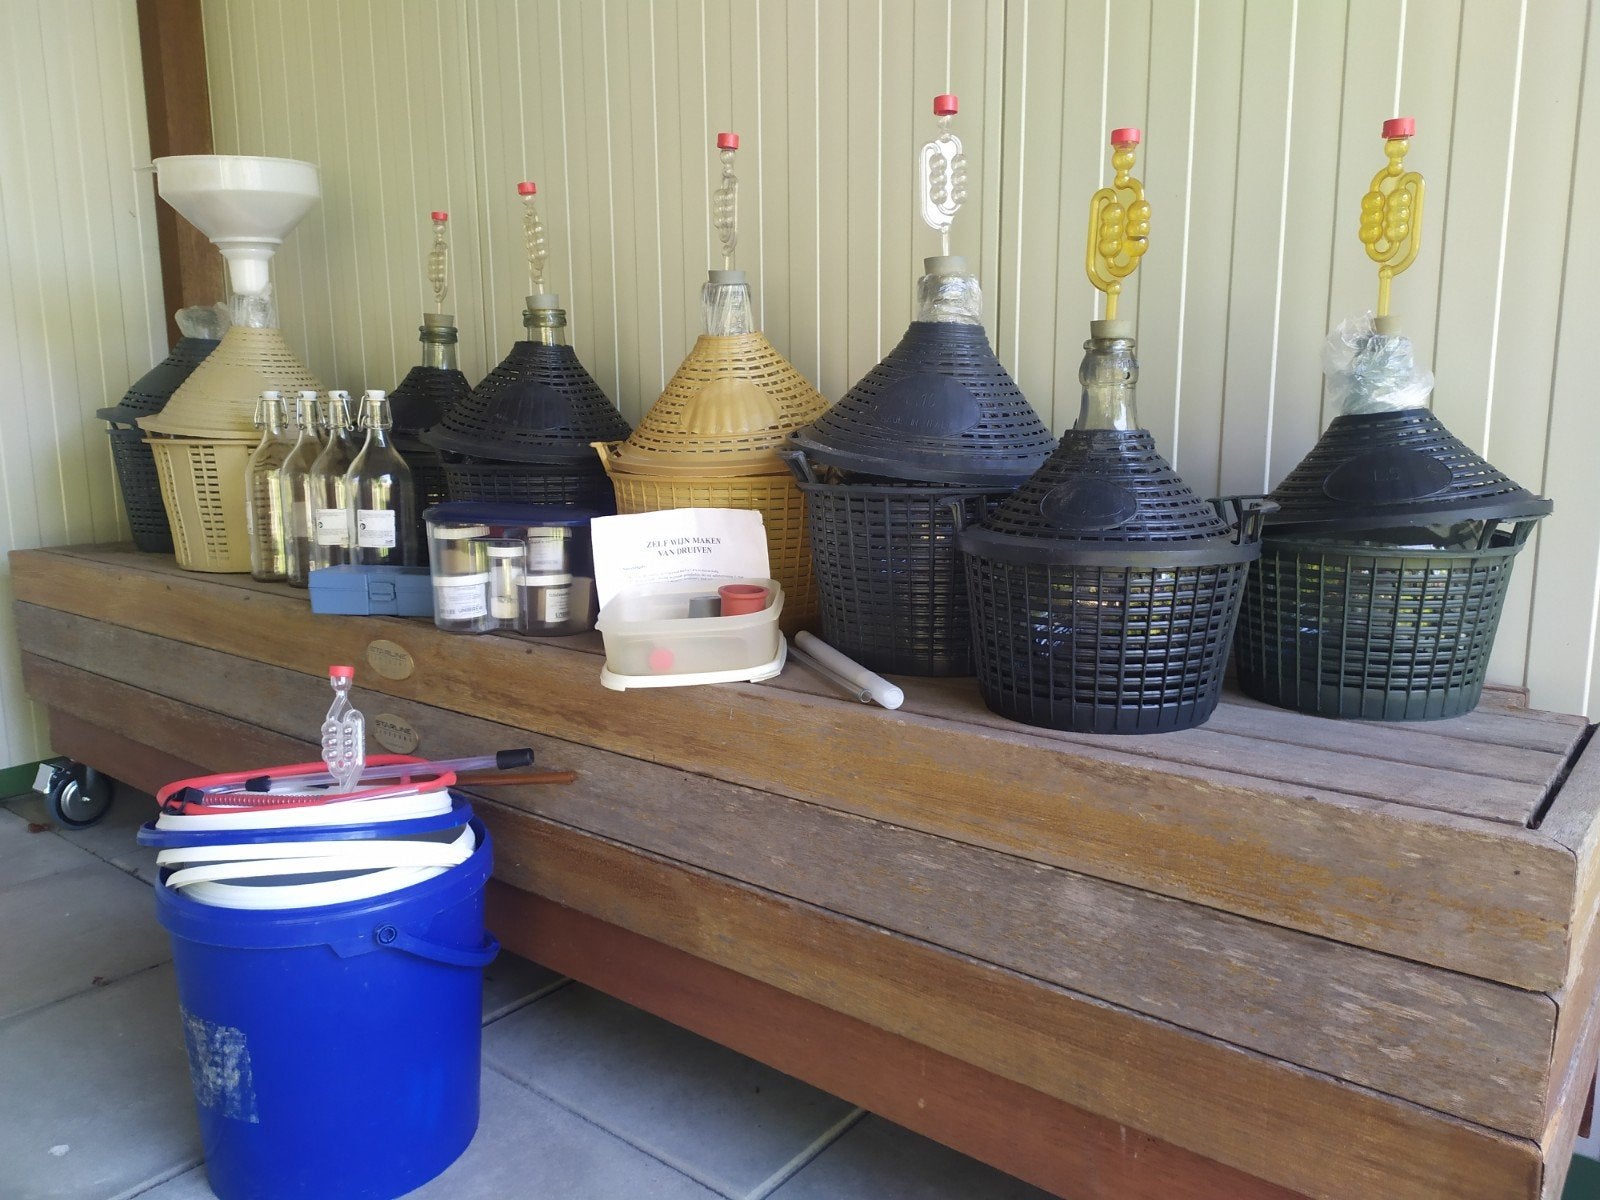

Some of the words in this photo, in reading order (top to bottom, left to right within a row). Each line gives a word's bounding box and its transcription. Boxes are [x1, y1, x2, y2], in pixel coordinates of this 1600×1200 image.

[646, 540, 669, 548] ZELF
[670, 537, 690, 546] WIJN
[692, 537, 722, 545] MAKEN
[657, 549, 675, 557] VAN
[676, 546, 713, 555] DRUIVEN
[375, 719, 411, 735] STARLINE
